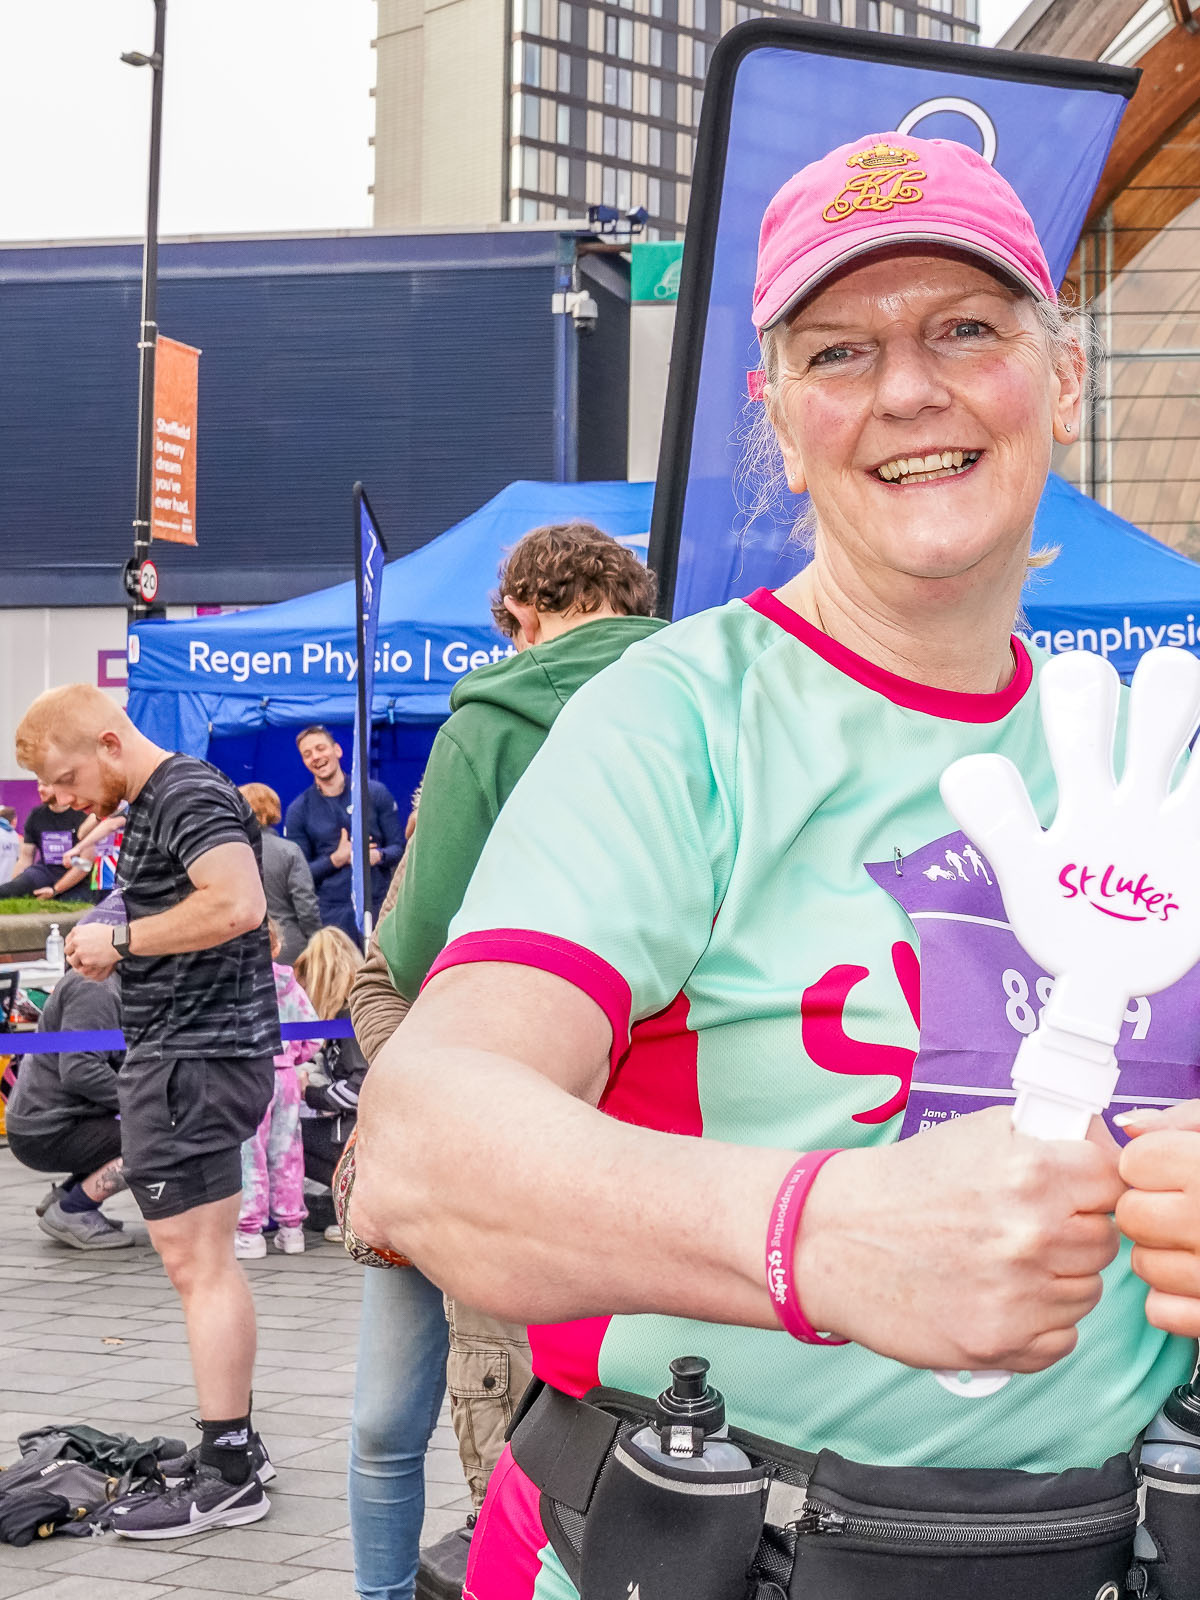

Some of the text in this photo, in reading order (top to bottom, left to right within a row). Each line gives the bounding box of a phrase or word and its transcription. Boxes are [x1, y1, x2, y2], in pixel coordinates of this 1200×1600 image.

[142, 572, 156, 591] 20
[189, 640, 291, 682] Regen
[1058, 863, 1179, 921] St Luke's
[922, 1108, 947, 1119] Jane
[770, 1185, 796, 1248] supporting
